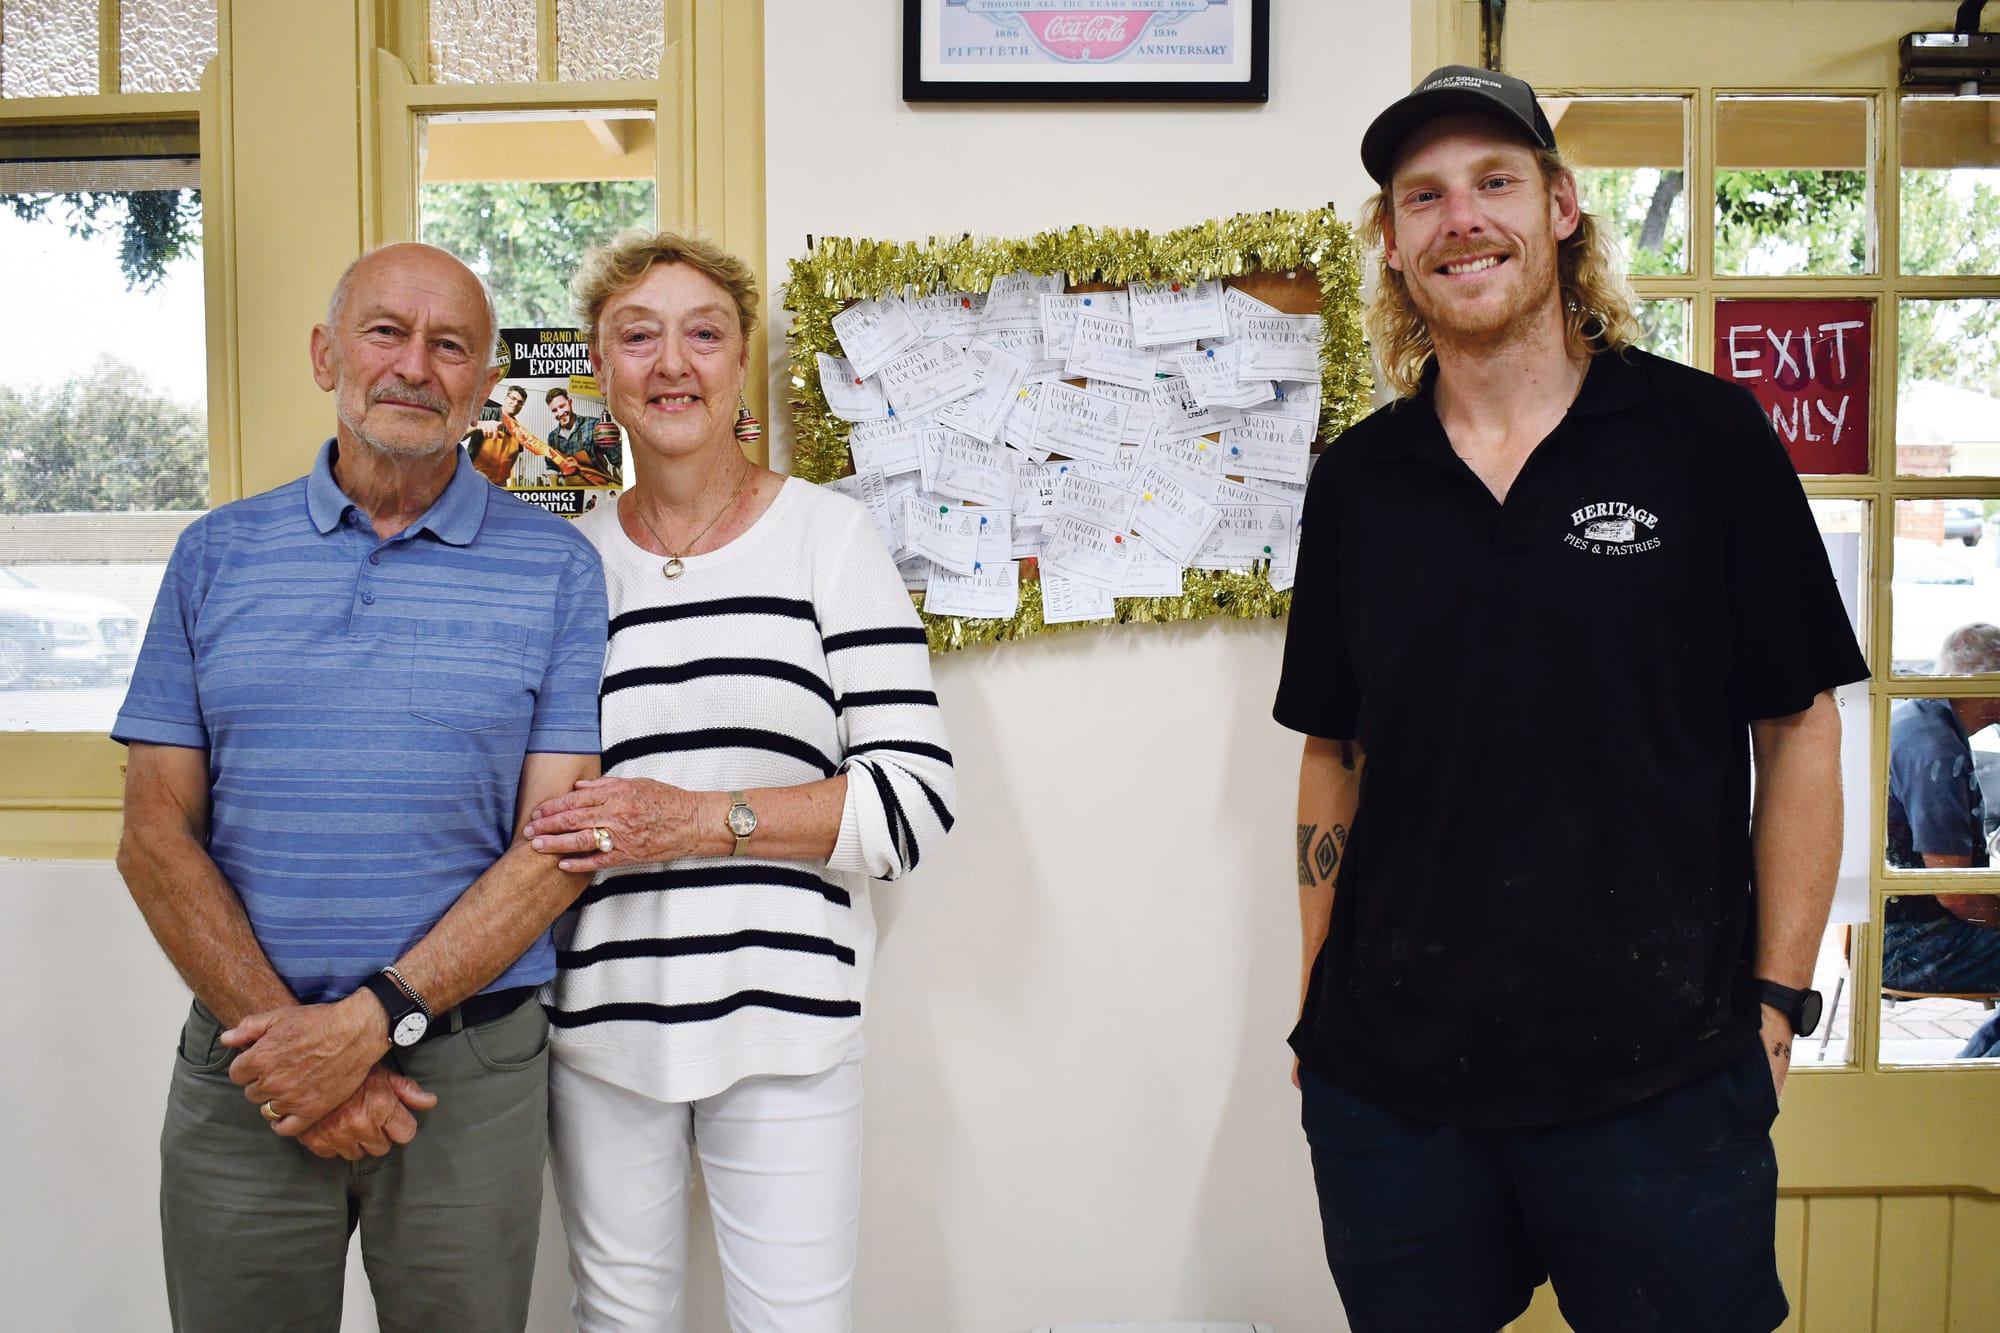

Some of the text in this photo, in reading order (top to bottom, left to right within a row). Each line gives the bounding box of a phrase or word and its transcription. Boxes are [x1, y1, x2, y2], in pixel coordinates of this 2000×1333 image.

[981, 0, 1195, 9] THROUGH ALL THE YEARS SINCE 1886
[995, 30, 1020, 38] 1886
[1044, 15, 1128, 42] Coca-Cola
[1153, 29, 1177, 37] 1936
[947, 45, 1227, 57] FIFTIETH ANNIVERSARY
[1456, 75, 1502, 88] SOUTHERN
[1083, 318, 1125, 335] BAKERY
[1248, 320, 1291, 331] BAKERY
[540, 331, 587, 345] BRAND NE
[1082, 330, 1135, 350] VOUCHER
[1248, 332, 1300, 343] VOUCHER
[515, 343, 589, 360] BLACKSMIT
[1729, 321, 1865, 380] EXIT
[530, 358, 592, 376] EXPERIEN
[1187, 409, 1209, 419] credit
[1765, 395, 1850, 445] NLY
[1065, 477, 1102, 496] BAKERY
[1063, 490, 1107, 509] VOUCHER
[1570, 501, 1659, 530] HERITAGE
[1065, 519, 1102, 538] BAKERY
[1062, 529, 1108, 553] VOUCHER
[1563, 532, 1661, 555] PIES & PASTRIES
